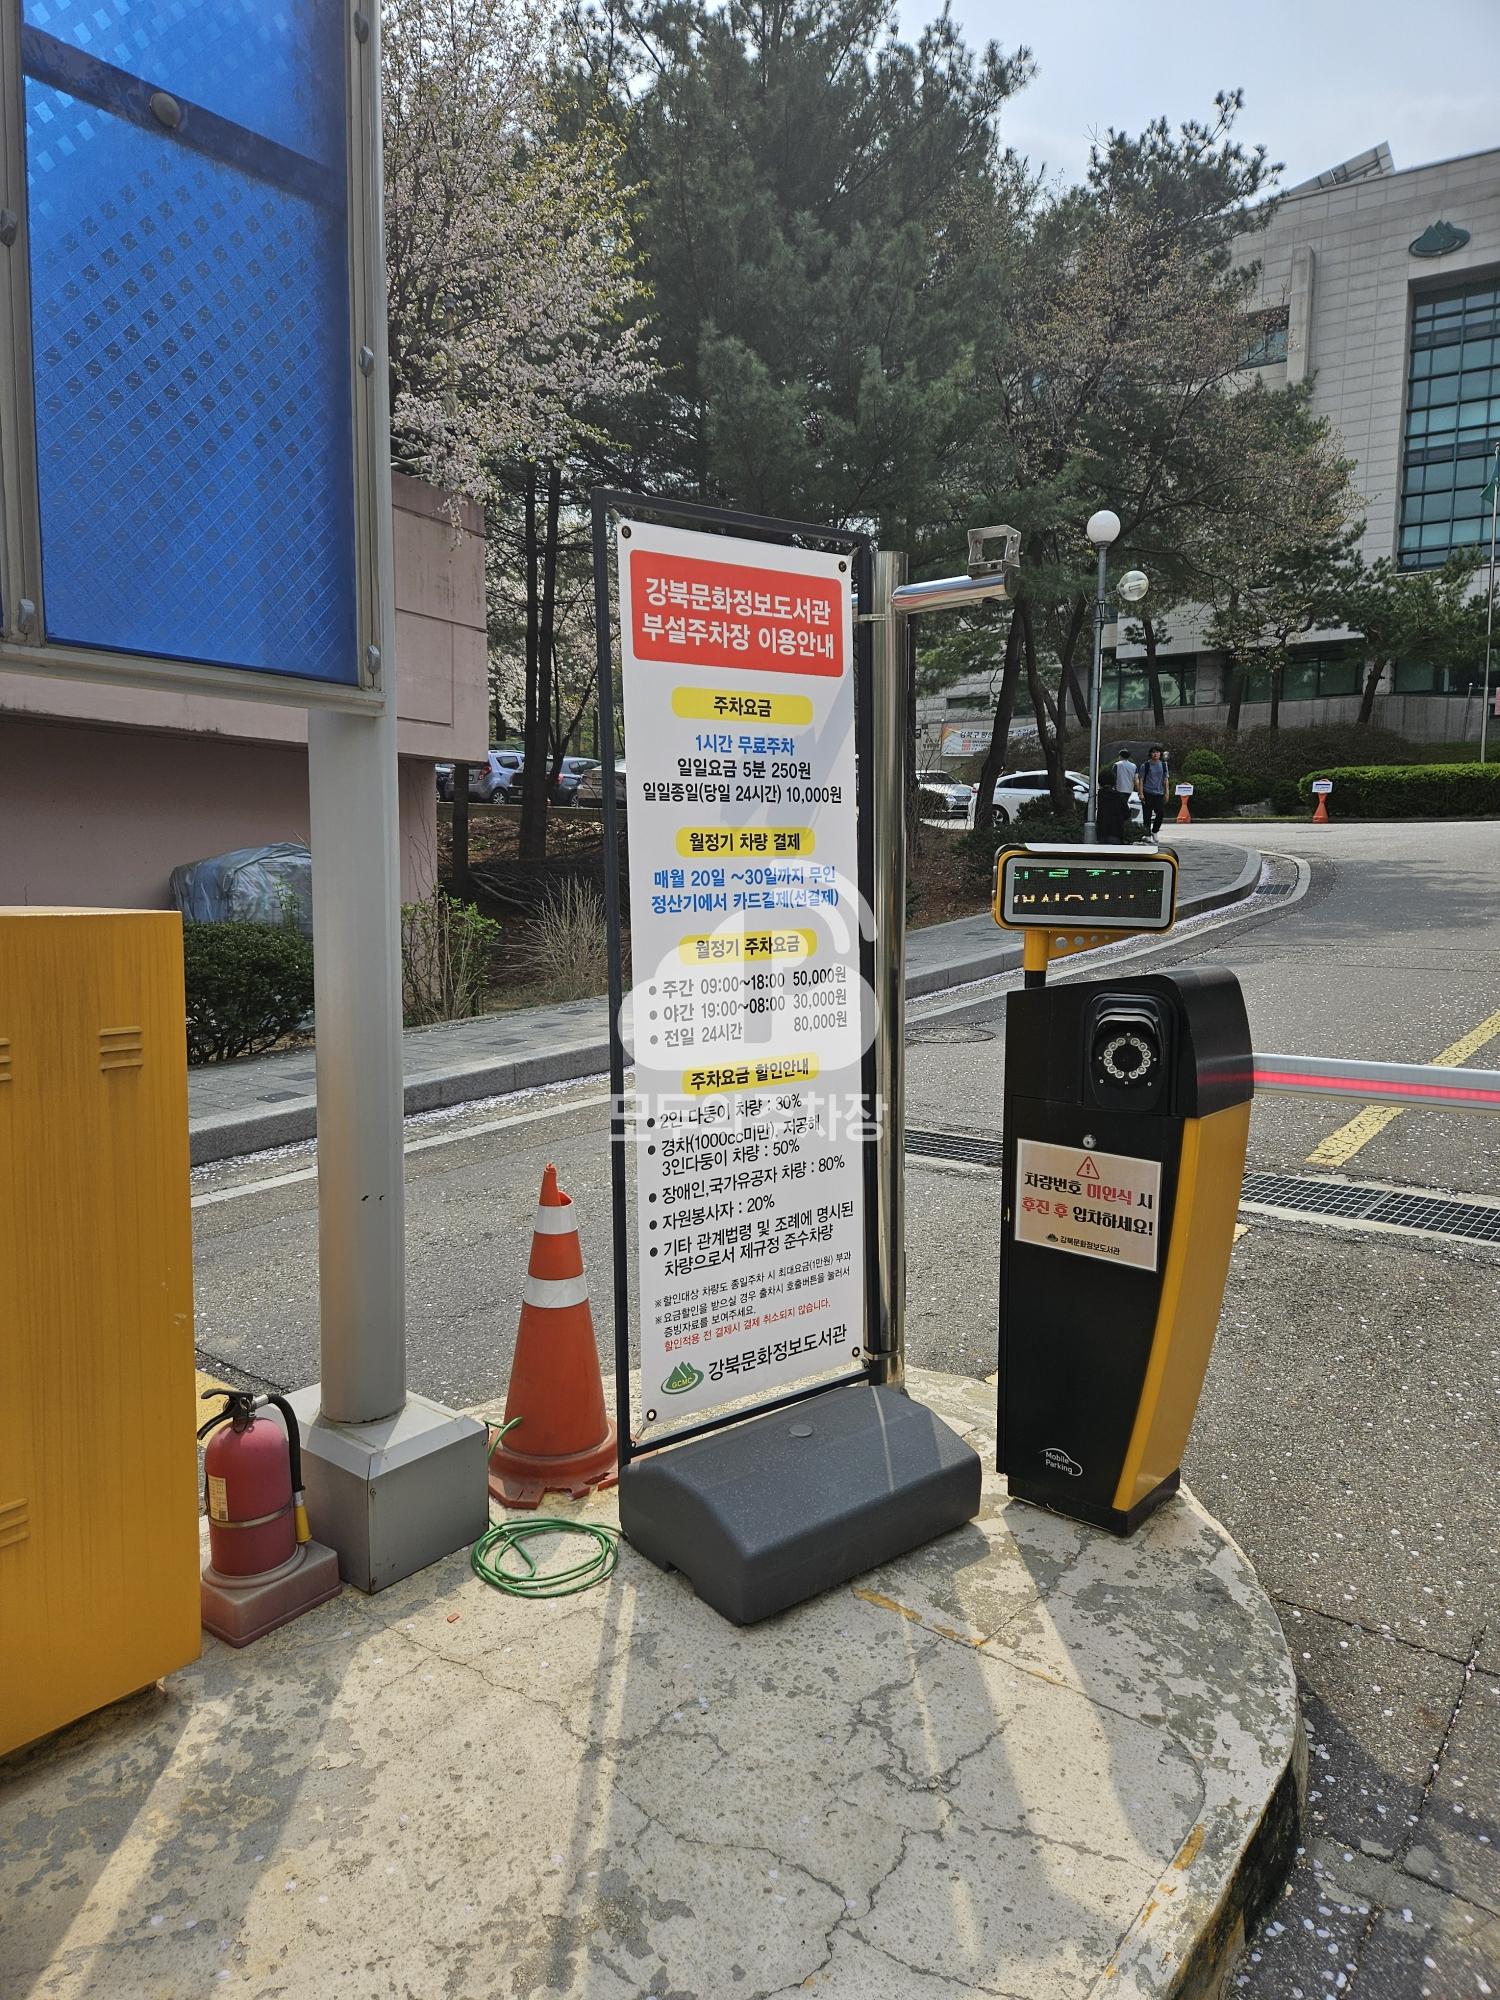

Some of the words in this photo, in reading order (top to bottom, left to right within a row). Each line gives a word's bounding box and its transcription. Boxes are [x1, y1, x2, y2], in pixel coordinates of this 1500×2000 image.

[645, 577, 831, 626] 강북문화정보도서관
[641, 612, 750, 651] 부설주차장
[758, 627, 834, 659] 이용안내
[713, 696, 772, 717] 주차요금
[695, 734, 732, 753] 1시간
[738, 735, 795, 756] 무료주차
[677, 758, 737, 778] 일일요금
[743, 760, 766, 779] 5분
[772, 762, 811, 781] 250원
[643, 782, 733, 803] 일일종일(당일
[735, 785, 782, 804] 24시간)
[786, 786, 842, 804] 10,000원
[689, 832, 734, 852] 월정기
[740, 833, 768, 852] 차량
[774, 833, 800, 851] 결제
[654, 868, 684, 889] 매월
[691, 868, 725, 887] 20일
[809, 865, 835, 884] 무인
[651, 893, 728, 914] 정산기에서
[733, 889, 839, 910] 카드결제(선결제)
[696, 938, 740, 959] 월정기
[744, 935, 800, 955] 주차요금
[662, 979, 694, 999] 주간
[701, 973, 785, 994] 09:00~18:00
[793, 966, 846, 987] 50,000원
[663, 1003, 694, 1022] 야간
[701, 996, 785, 1019] 19:00~08:00
[793, 988, 847, 1009] 30,000원
[664, 1028, 694, 1047] 전일
[701, 1022, 743, 1043] 24시간
[793, 1011, 847, 1032] 80,000원
[690, 1067, 750, 1091] 주차요금
[756, 1058, 809, 1081] 할인안내
[660, 1110, 684, 1130] 2인
[688, 1103, 730, 1126] 다둥이
[735, 1099, 763, 1119] 차량
[774, 1093, 802, 1111] 30%
[783, 1114, 820, 1135] 저공해
[662, 1149, 727, 1177] 3인다둥이
[732, 1143, 760, 1163] 차량
[773, 1138, 800, 1157] 50%
[662, 1167, 777, 1204] 장애인,국가유공자
[782, 1160, 807, 1180] 차량
[818, 1154, 845, 1174] 80%
[1024, 1172, 1082, 1195] 차량번호
[1087, 1183, 1132, 1206] 미인식
[1137, 1192, 1153, 1210] 시
[662, 1201, 734, 1231] 자원봉사자
[747, 1193, 775, 1213] 20%
[664, 1235, 692, 1257] 기타
[697, 1222, 752, 1250] 관계법령
[757, 1218, 770, 1238] 및
[776, 1209, 813, 1233] 조례에
[817, 1200, 854, 1224] 명시된
[1022, 1196, 1050, 1215] 후진
[1053, 1202, 1069, 1218] 후
[1073, 1205, 1153, 1236] 입차하세요!
[664, 1248, 736, 1277] 차량으로서
[740, 1237, 780, 1260] 제규정
[784, 1224, 833, 1250] 준수차량
[702, 1282, 728, 1296] 차량도
[768, 1270, 776, 1280] 시
[836, 1251, 851, 1262] 부과
[740, 1290, 756, 1303] 경우
[703, 1330, 712, 1341] 전
[708, 1323, 848, 1381] 강북문화정보도서관
[1045, 1451, 1069, 1465] Mobile
[1045, 1458, 1073, 1475] Parking
